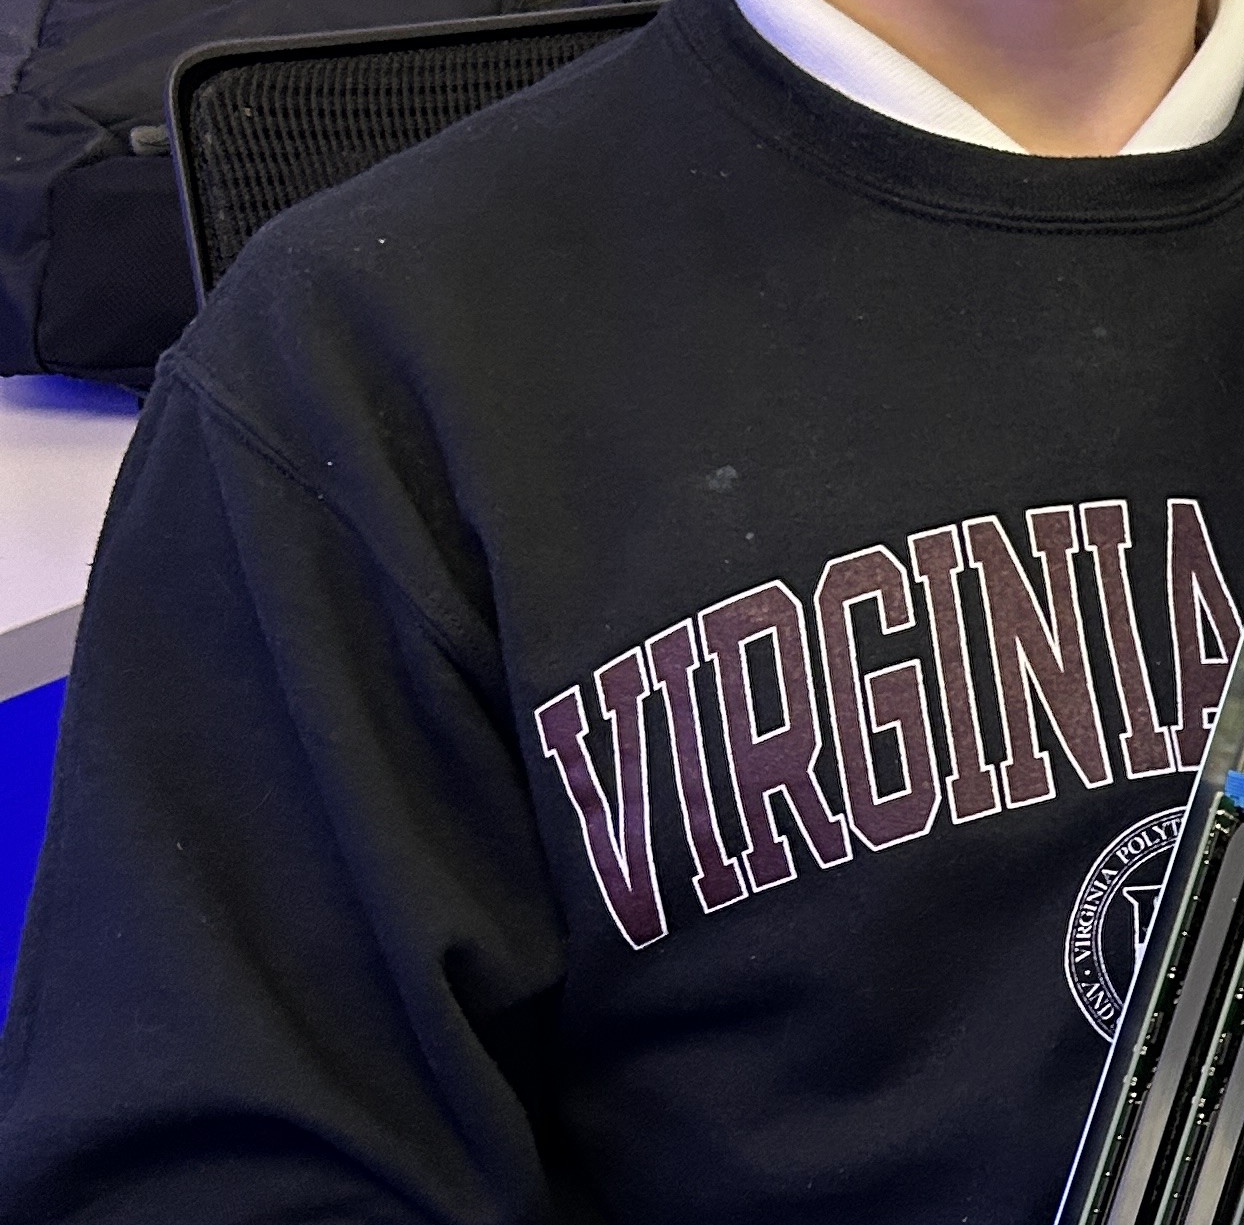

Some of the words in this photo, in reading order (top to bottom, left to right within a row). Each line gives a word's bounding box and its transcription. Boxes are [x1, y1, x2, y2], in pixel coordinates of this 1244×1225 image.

[534, 498, 1244, 951] VIRGINIA
[1074, 866, 1118, 963] VIRGINIA
[1081, 981, 1115, 1021] AND
